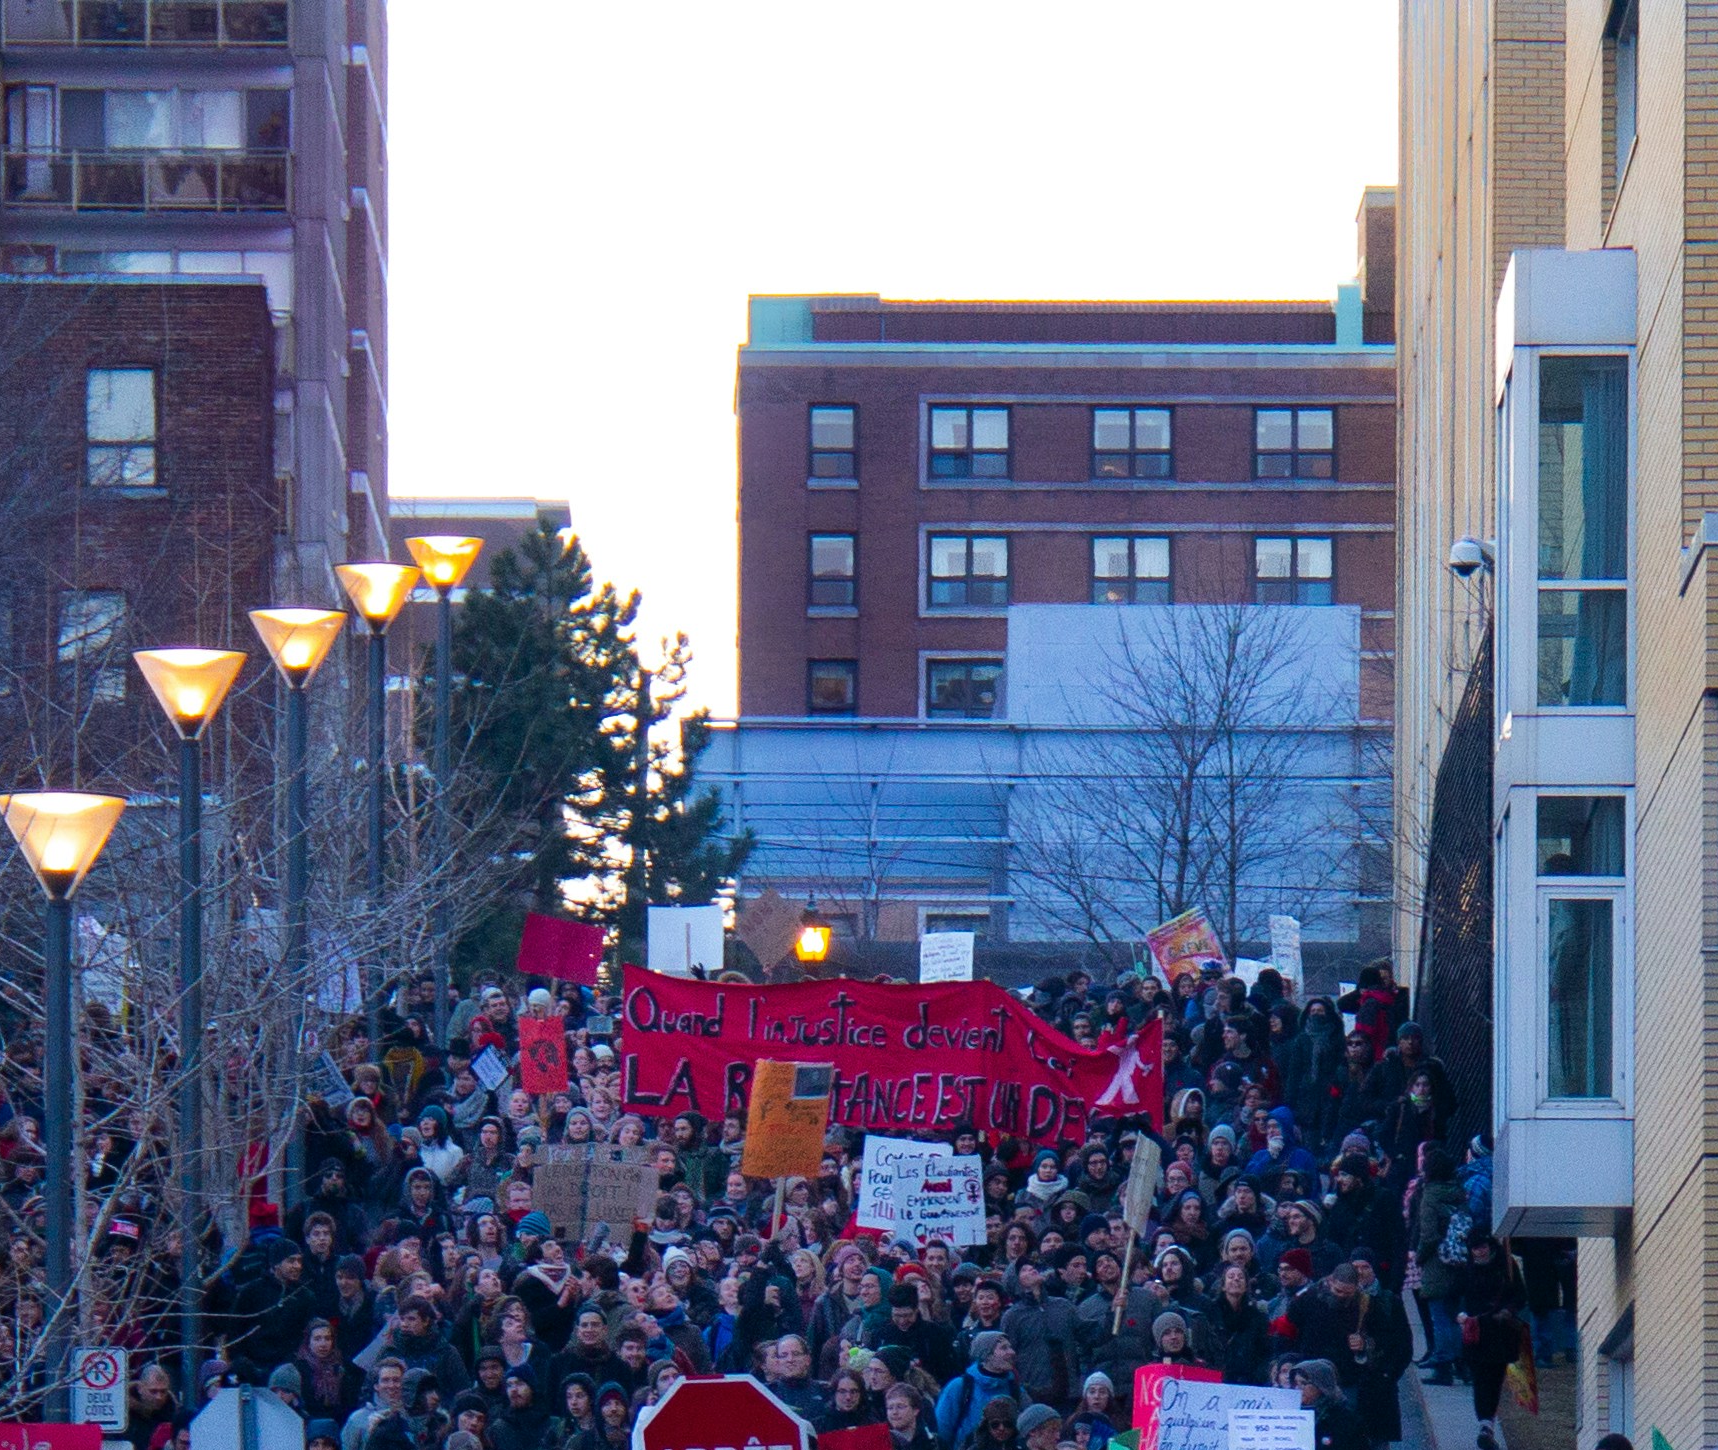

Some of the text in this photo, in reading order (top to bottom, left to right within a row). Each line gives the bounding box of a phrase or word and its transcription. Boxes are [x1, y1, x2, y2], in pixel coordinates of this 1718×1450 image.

[625, 985, 725, 1039] Quand
[903, 1002, 1013, 1054] devient
[623, 1054, 697, 1111] LA
[932, 1074, 987, 1127] EST
